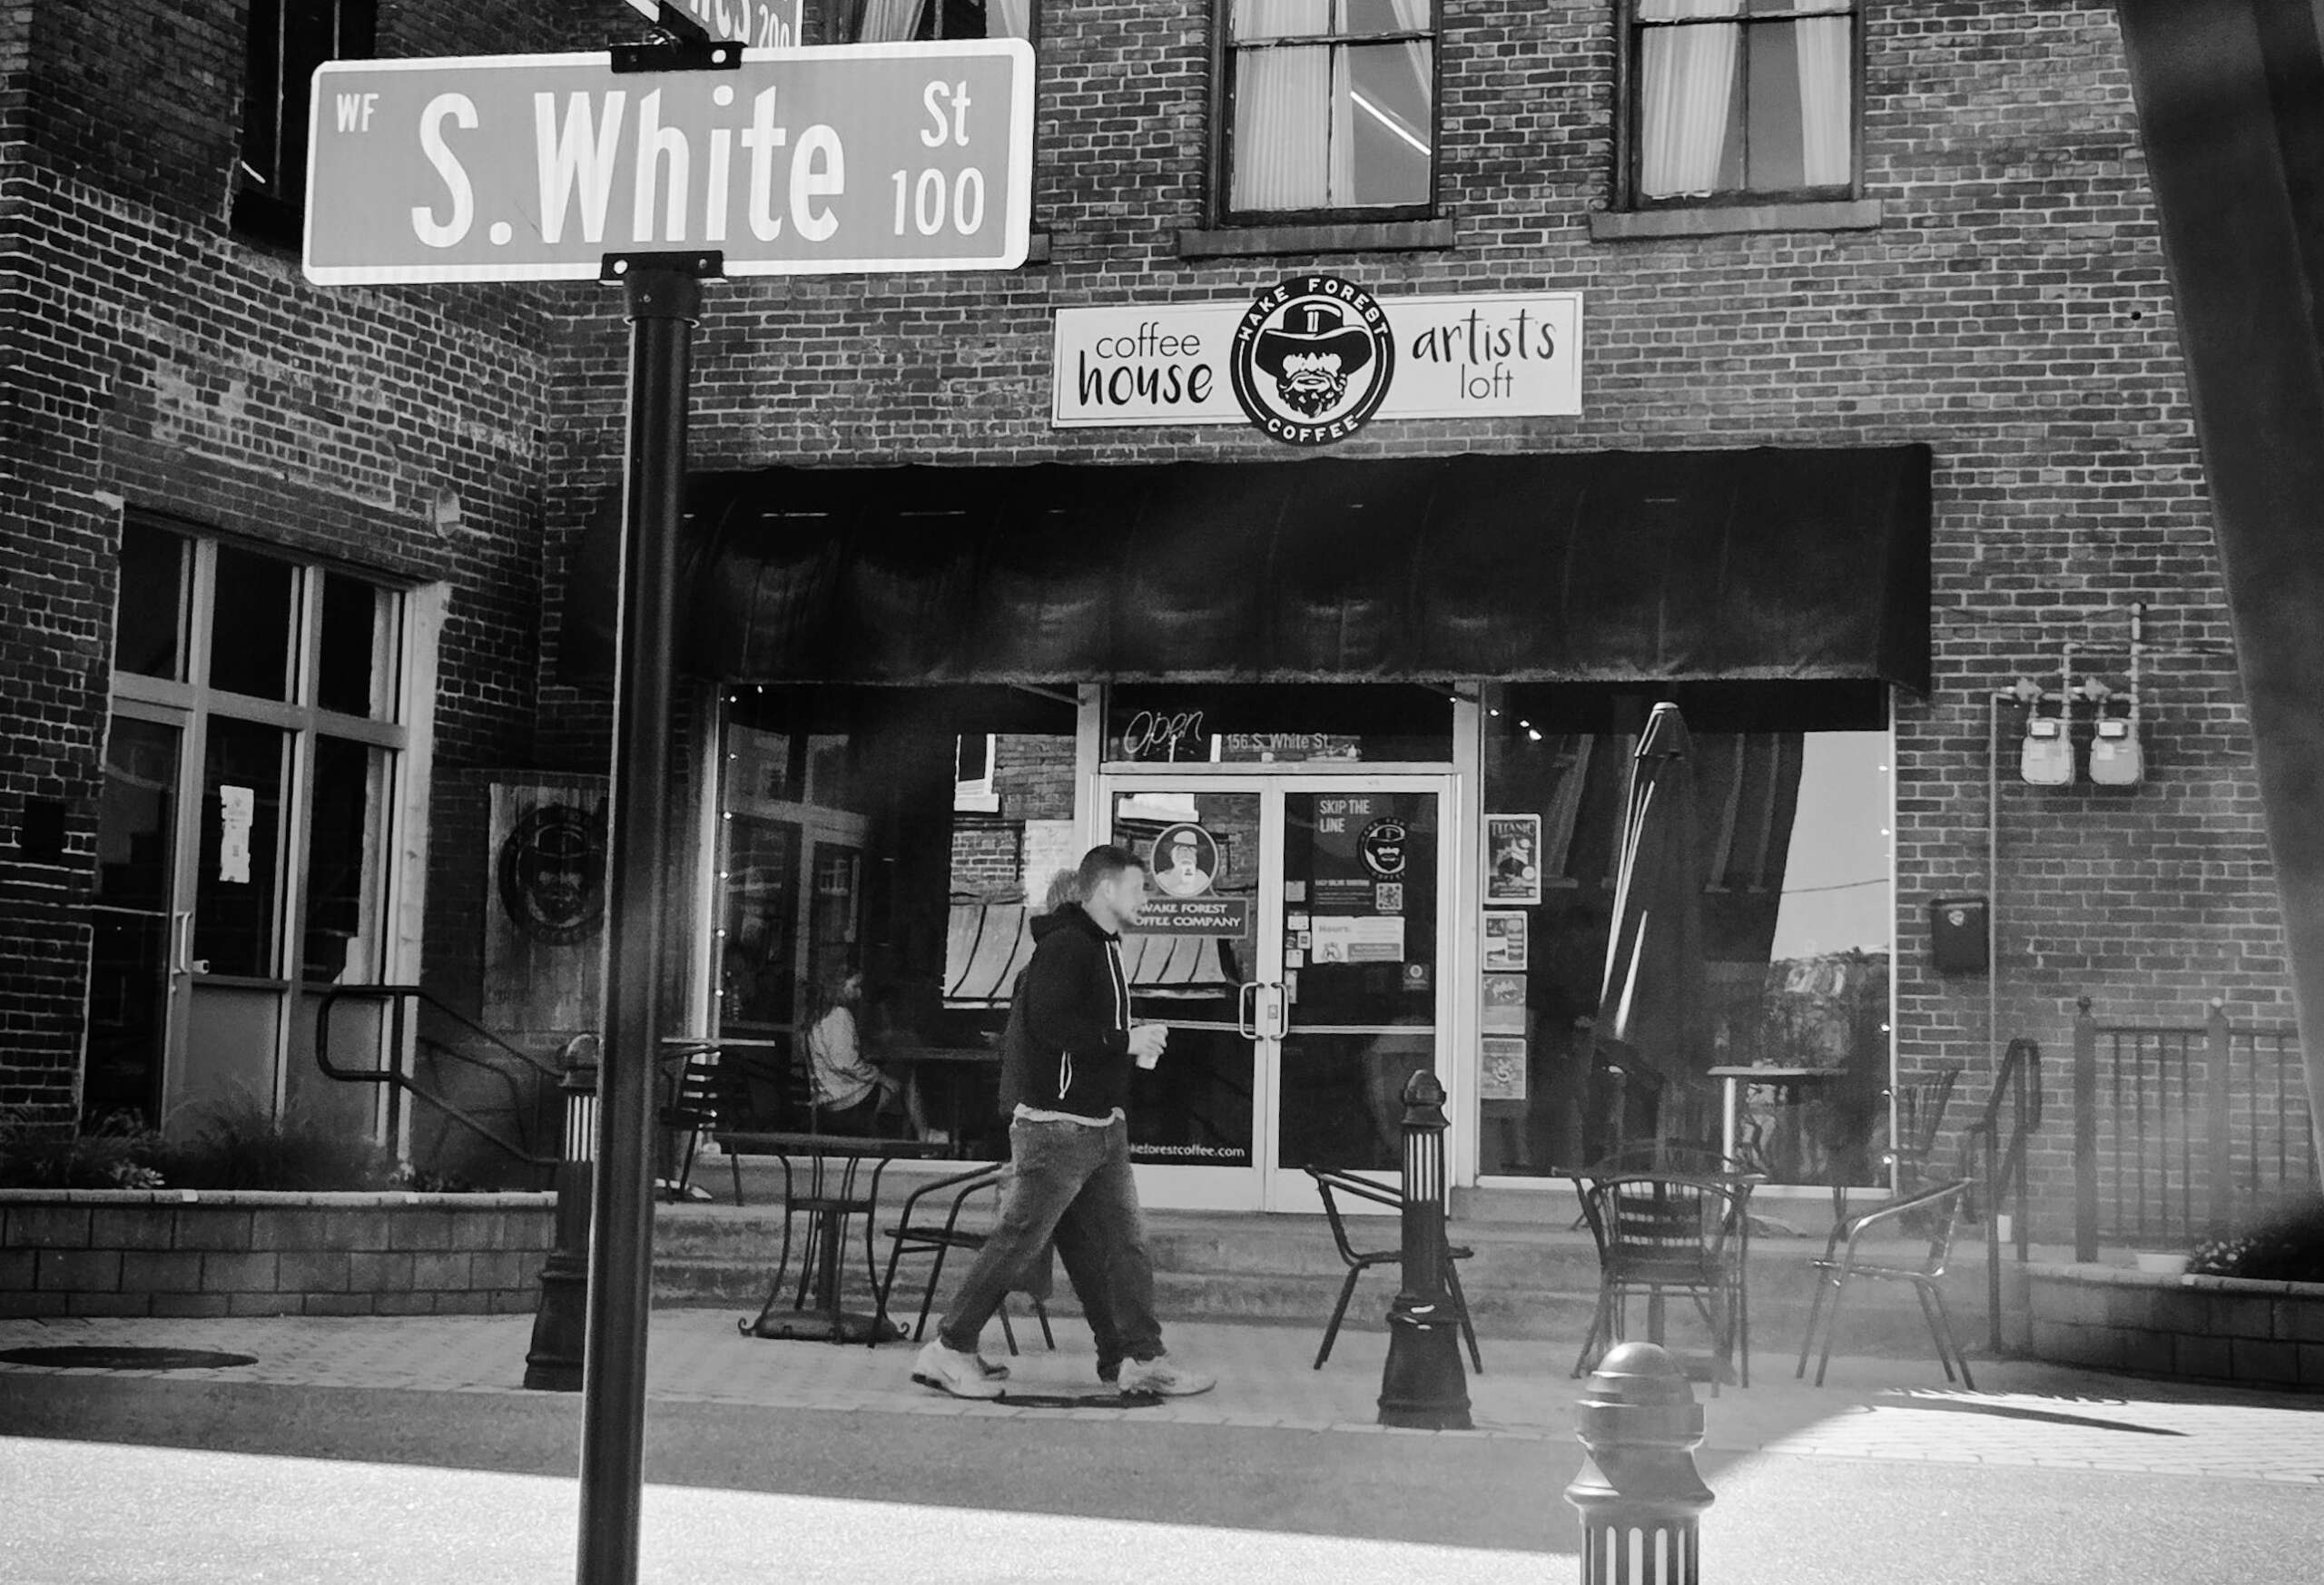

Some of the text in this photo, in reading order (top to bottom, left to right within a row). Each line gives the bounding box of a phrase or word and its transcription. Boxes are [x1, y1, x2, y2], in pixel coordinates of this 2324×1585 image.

[336, 94, 379, 133] WF
[920, 79, 972, 149] St
[411, 84, 845, 249] S. White
[891, 167, 985, 236] 100
[1238, 278, 1389, 341] WAKE FOREST
[1097, 321, 1200, 359] coffee
[1079, 349, 1214, 406] house
[1461, 362, 1514, 399] loft
[1267, 414, 1359, 443] COFFEE
[1123, 711, 1204, 756] Open
[1226, 733, 1248, 750] 156
[1270, 733, 1309, 750] White
[1319, 799, 1370, 814] SKIP THE
[1319, 817, 1345, 833] LINE
[1134, 915, 1241, 928] OFFEE COMPANY
[1142, 903, 1227, 914] WAKE FOREST
[1129, 1142, 1246, 1157] keforestcoffee.com
